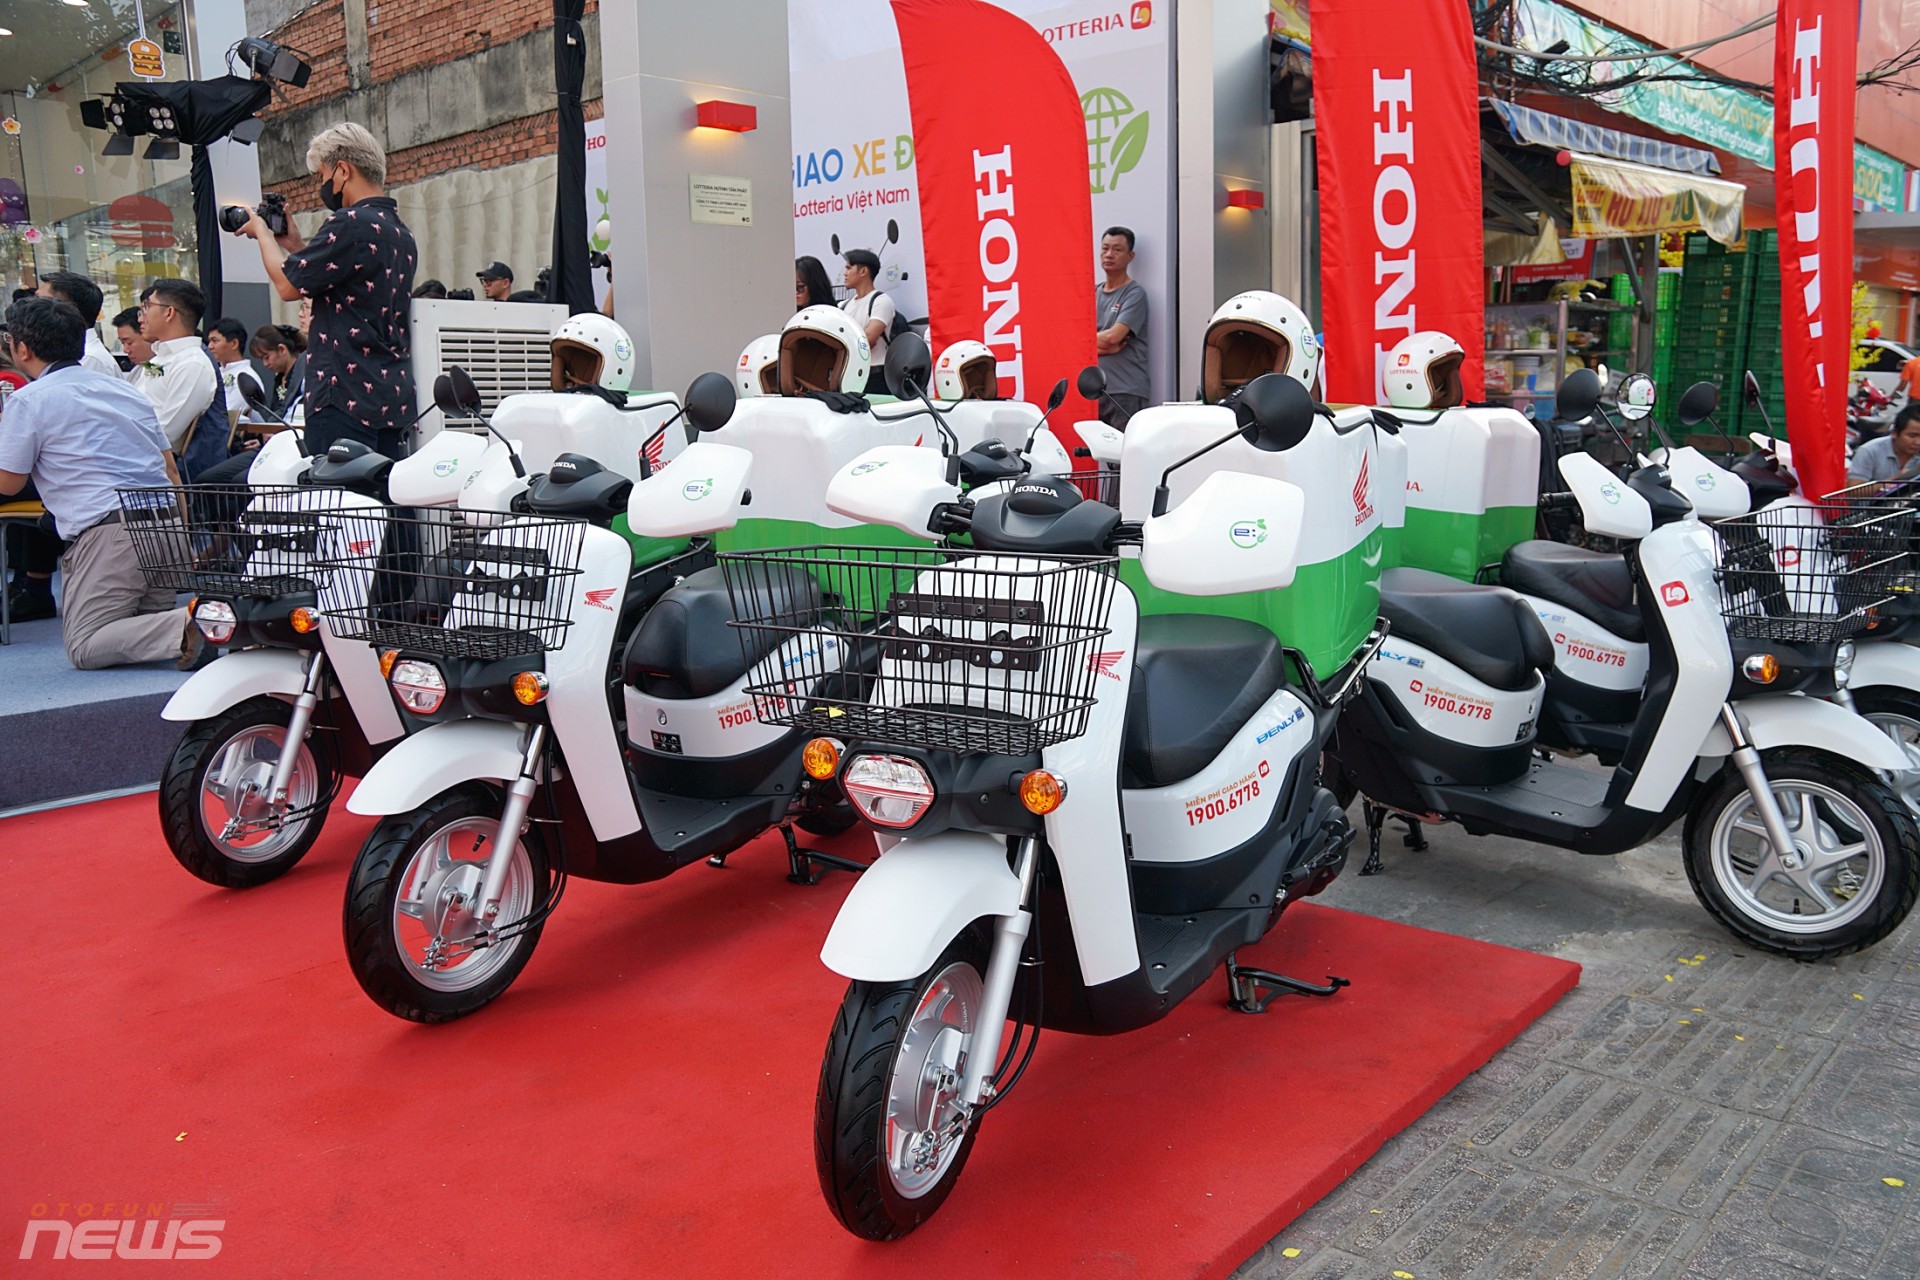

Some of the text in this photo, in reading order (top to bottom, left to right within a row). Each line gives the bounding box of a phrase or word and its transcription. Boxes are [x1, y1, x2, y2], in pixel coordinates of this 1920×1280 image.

[792, 148, 843, 188] IAO
[852, 138, 885, 178] XE
[794, 188, 910, 218] Lotteria Việt Nam
[1790, 14, 1824, 387] HON
[1014, 485, 1059, 498] HONDA
[1354, 505, 1375, 527] HONDA
[583, 600, 614, 612] HONDA
[1566, 644, 1626, 667] 1900.6778
[717, 705, 735, 716] MIỄN
[736, 702, 748, 711] PHÍ
[1424, 693, 1492, 720] 1900.6778
[1426, 686, 1495, 707] MIỄN PHÍ GIAO HÀNG
[1256, 715, 1295, 744] BENLY
[1185, 771, 1257, 809] MIỄN PHÍ GIAO HÀNG
[1187, 780, 1260, 826] 1900.6778
